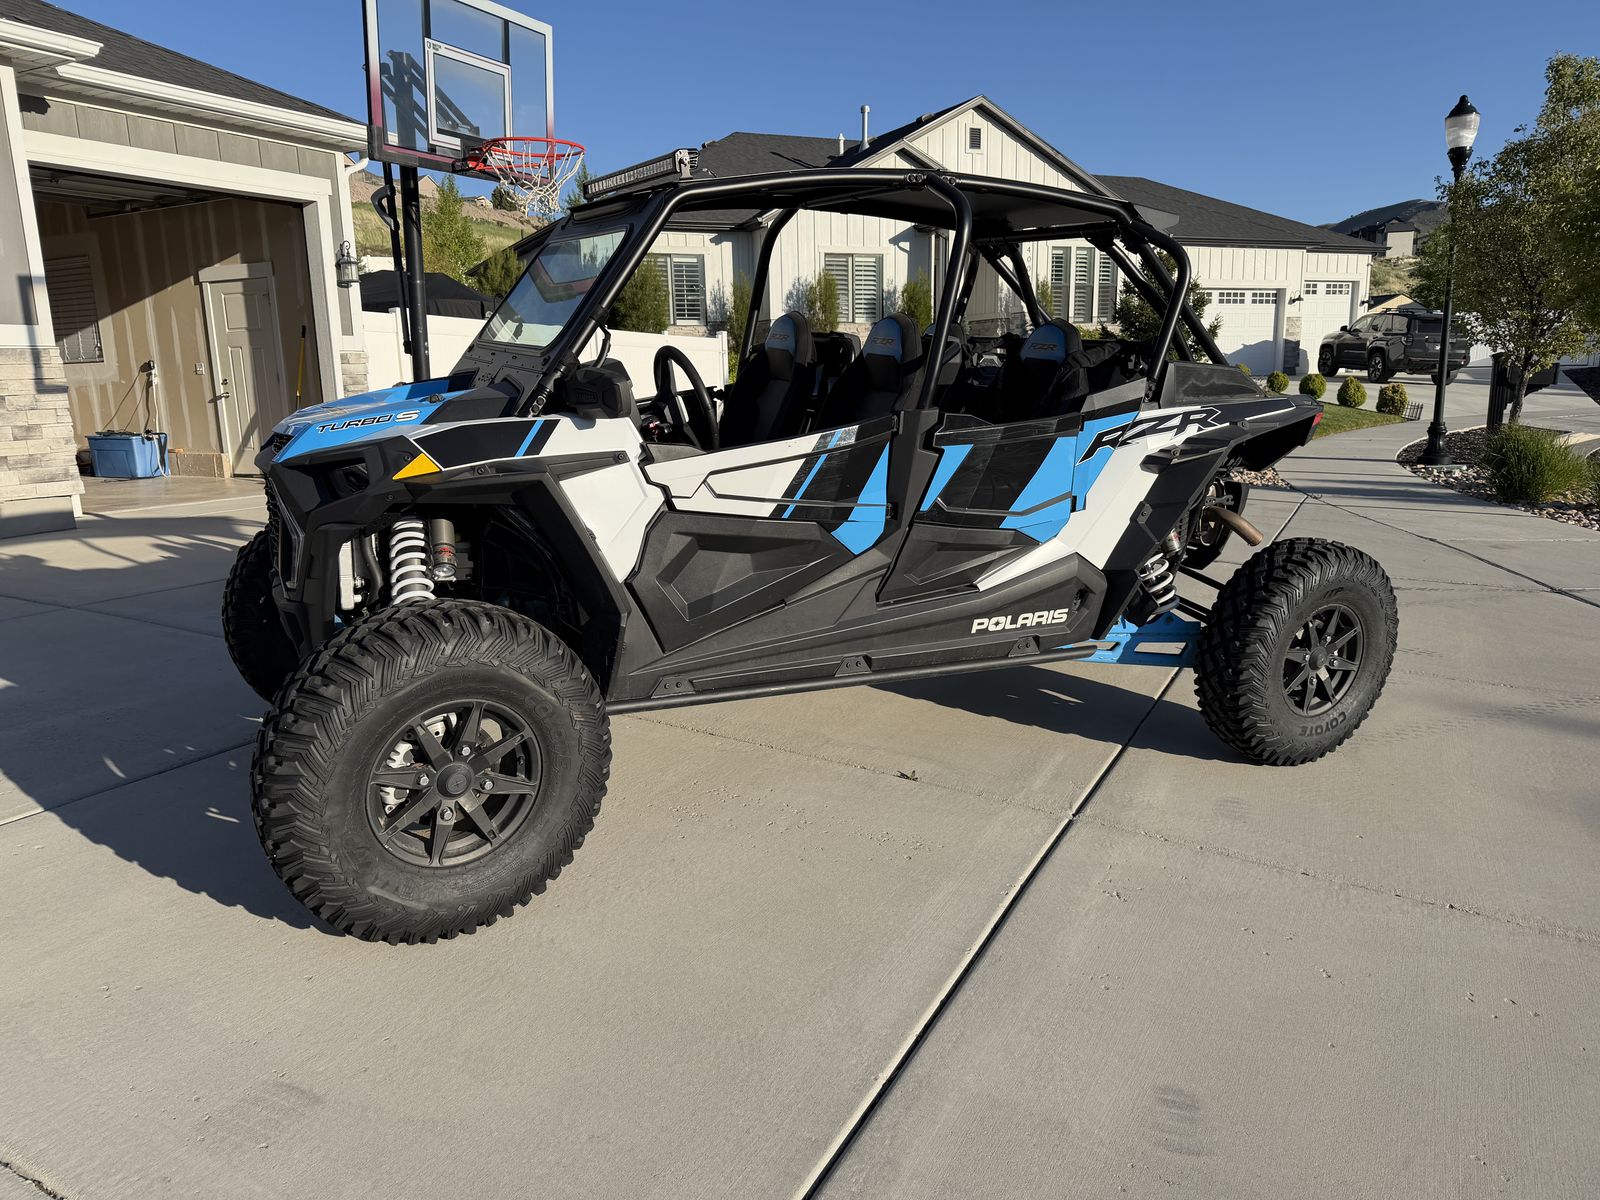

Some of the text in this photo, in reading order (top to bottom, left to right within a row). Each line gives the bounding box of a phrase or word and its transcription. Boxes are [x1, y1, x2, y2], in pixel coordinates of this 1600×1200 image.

[316, 409, 421, 433] TURBO S
[1075, 406, 1222, 467] RZR
[970, 608, 1069, 634] POLARIS
[1298, 711, 1347, 737] COYOTE
